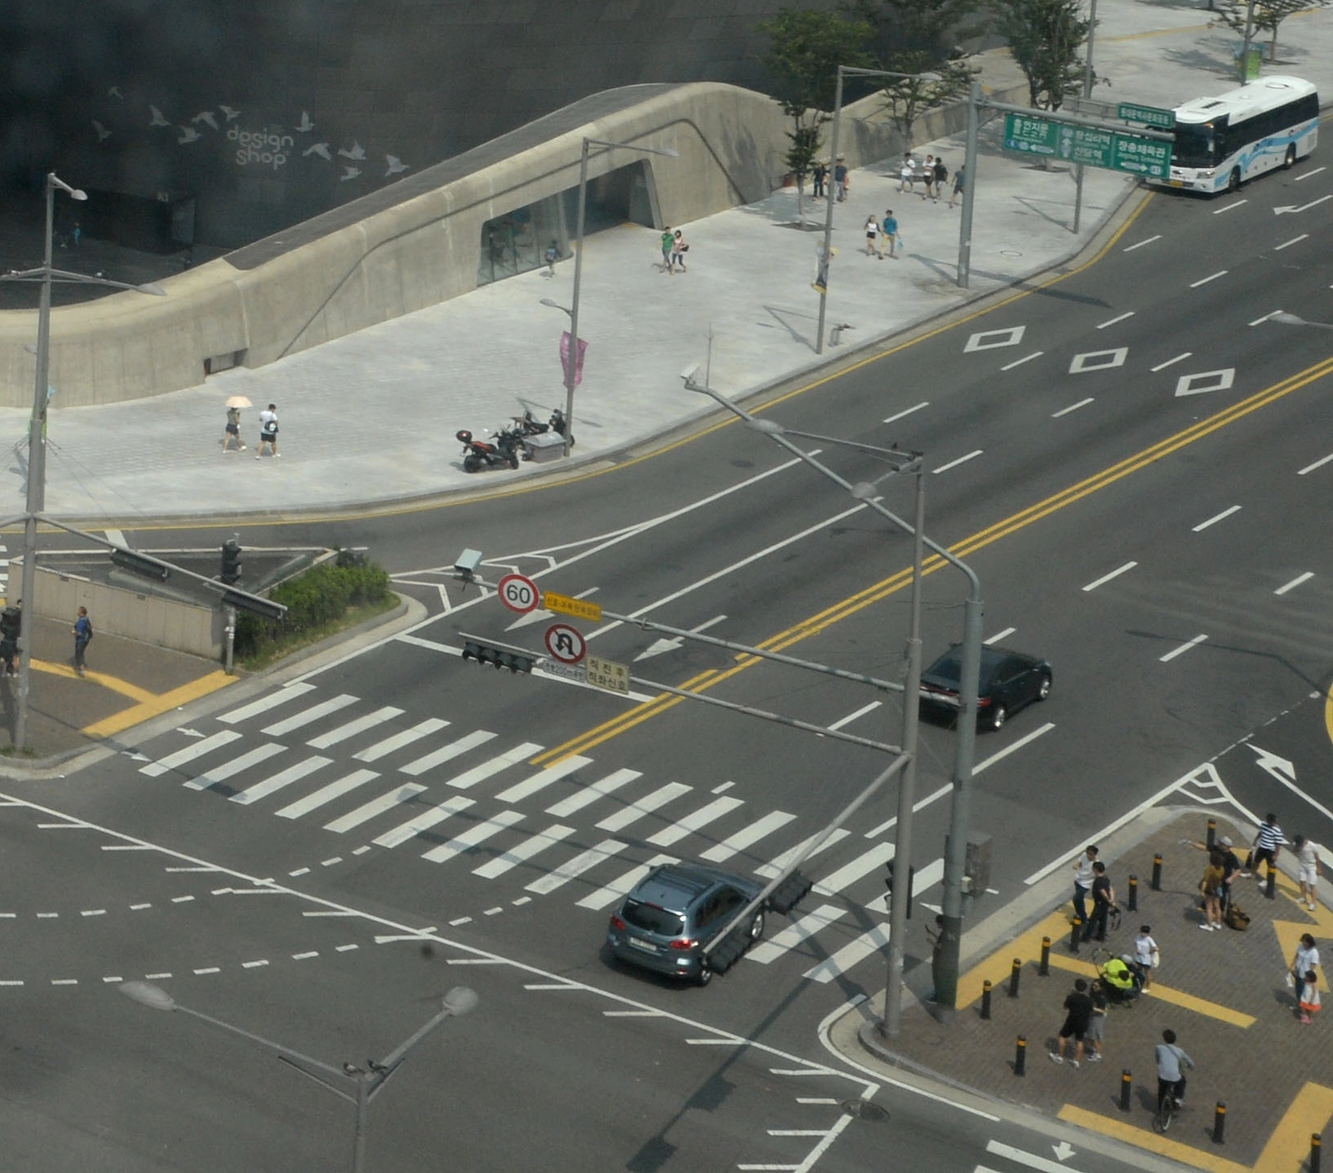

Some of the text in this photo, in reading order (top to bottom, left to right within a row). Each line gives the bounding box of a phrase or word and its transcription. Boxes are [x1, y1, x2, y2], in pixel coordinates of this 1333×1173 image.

[227, 124, 294, 153] design
[236, 146, 286, 171] shop
[506, 584, 531, 604] 60
